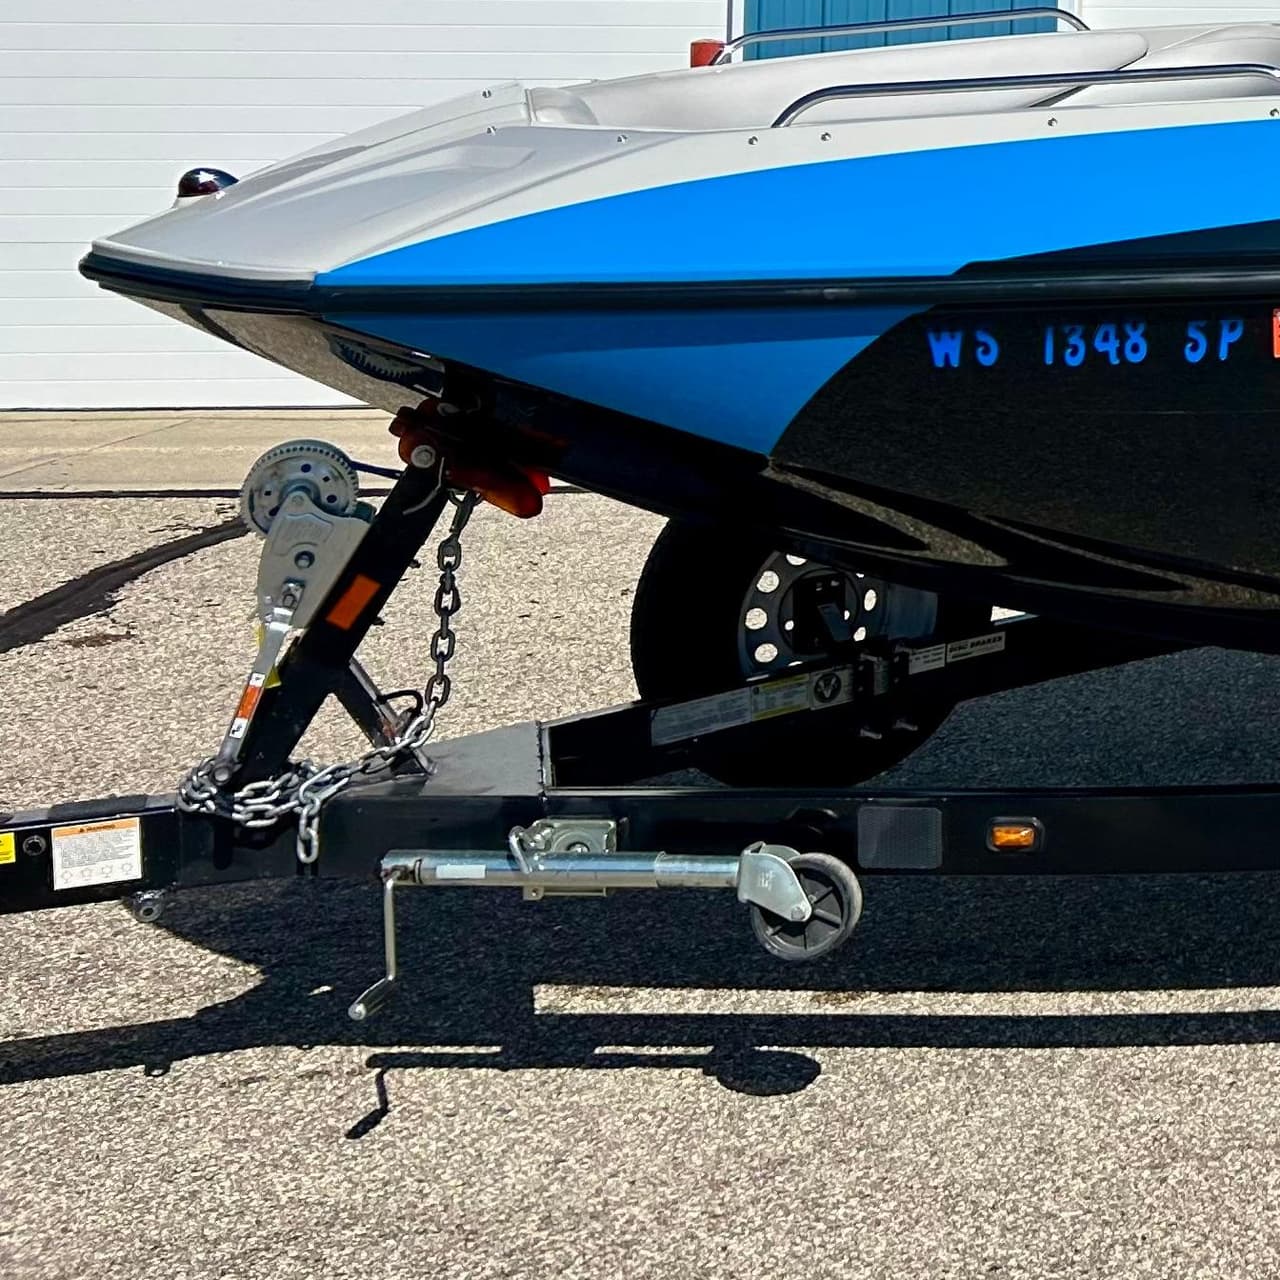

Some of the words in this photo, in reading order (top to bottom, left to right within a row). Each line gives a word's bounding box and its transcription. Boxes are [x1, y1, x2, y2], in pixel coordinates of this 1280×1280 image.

[926, 328, 1001, 369] WS
[1043, 320, 1149, 368] 1348
[1183, 318, 1245, 365] SP
